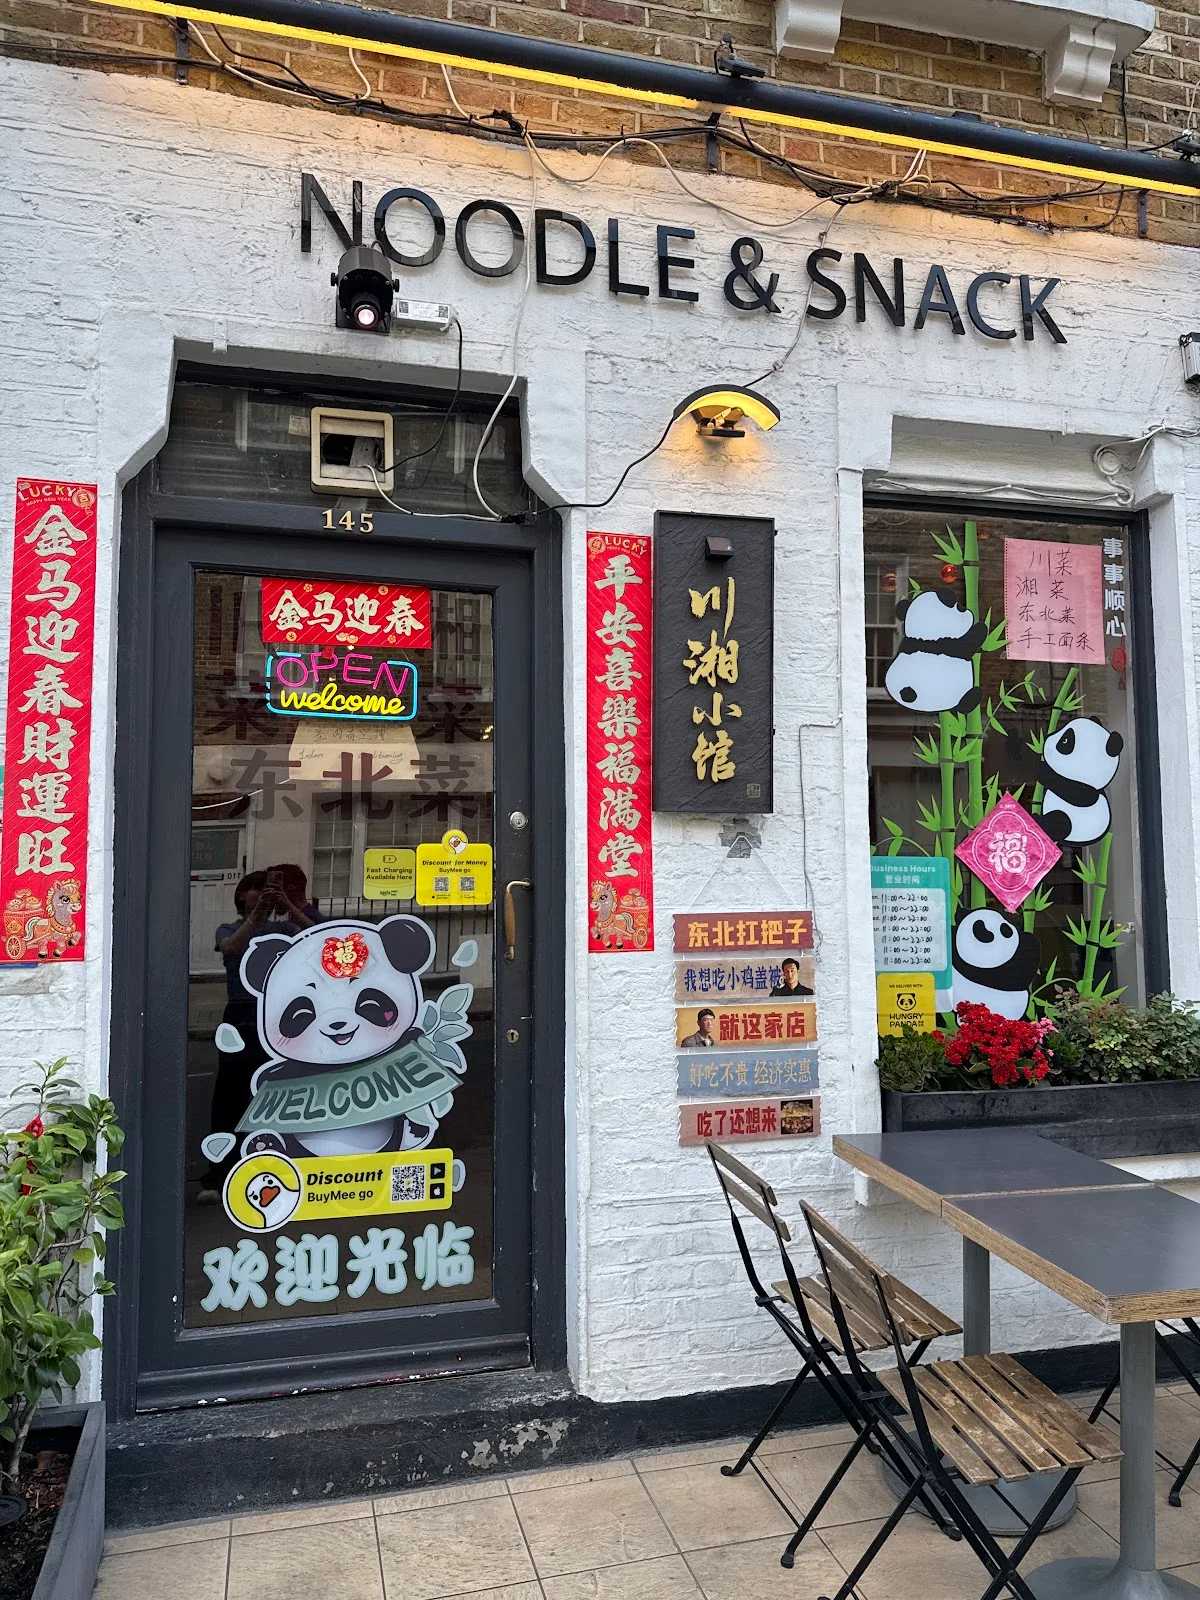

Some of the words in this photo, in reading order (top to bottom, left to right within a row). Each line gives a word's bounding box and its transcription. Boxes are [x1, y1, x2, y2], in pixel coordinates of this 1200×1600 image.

[301, 172, 699, 302] NOODLE
[723, 236, 782, 314] &
[806, 248, 1068, 344] SNACK
[18, 484, 77, 502] LUCKY
[322, 509, 374, 533] 145
[605, 536, 647, 556] LUCKY
[1029, 548, 1073, 577] 川菜
[1015, 575, 1069, 601] 湘菜
[1102, 537, 1127, 638] 事事顺心
[269, 589, 425, 637] 金马迎春
[1018, 601, 1076, 625] 东北菜
[1016, 626, 1095, 652] 手工面条
[276, 652, 409, 697] OPEN
[682, 576, 743, 783] 川湘小馆
[280, 682, 406, 715] welcome
[227, 749, 480, 822] 东北菜
[454, 860, 465, 868] for
[910, 865, 937, 873] Hours
[885, 874, 920, 885] 营业时间
[687, 918, 807, 948] 东北扛把子
[718, 1010, 806, 1042] 就这家店
[889, 1012, 924, 1020] HUNGRY
[252, 1053, 446, 1121] WELCOME
[689, 1060, 749, 1088] 好吃不贵
[753, 1058, 812, 1086] 经济实惠
[696, 1104, 777, 1138] 吃了还想来
[306, 1168, 384, 1186] Discount
[306, 1190, 356, 1203] BuyMee
[358, 1190, 374, 1204] go
[199, 1220, 476, 1313] 欢迎光临
